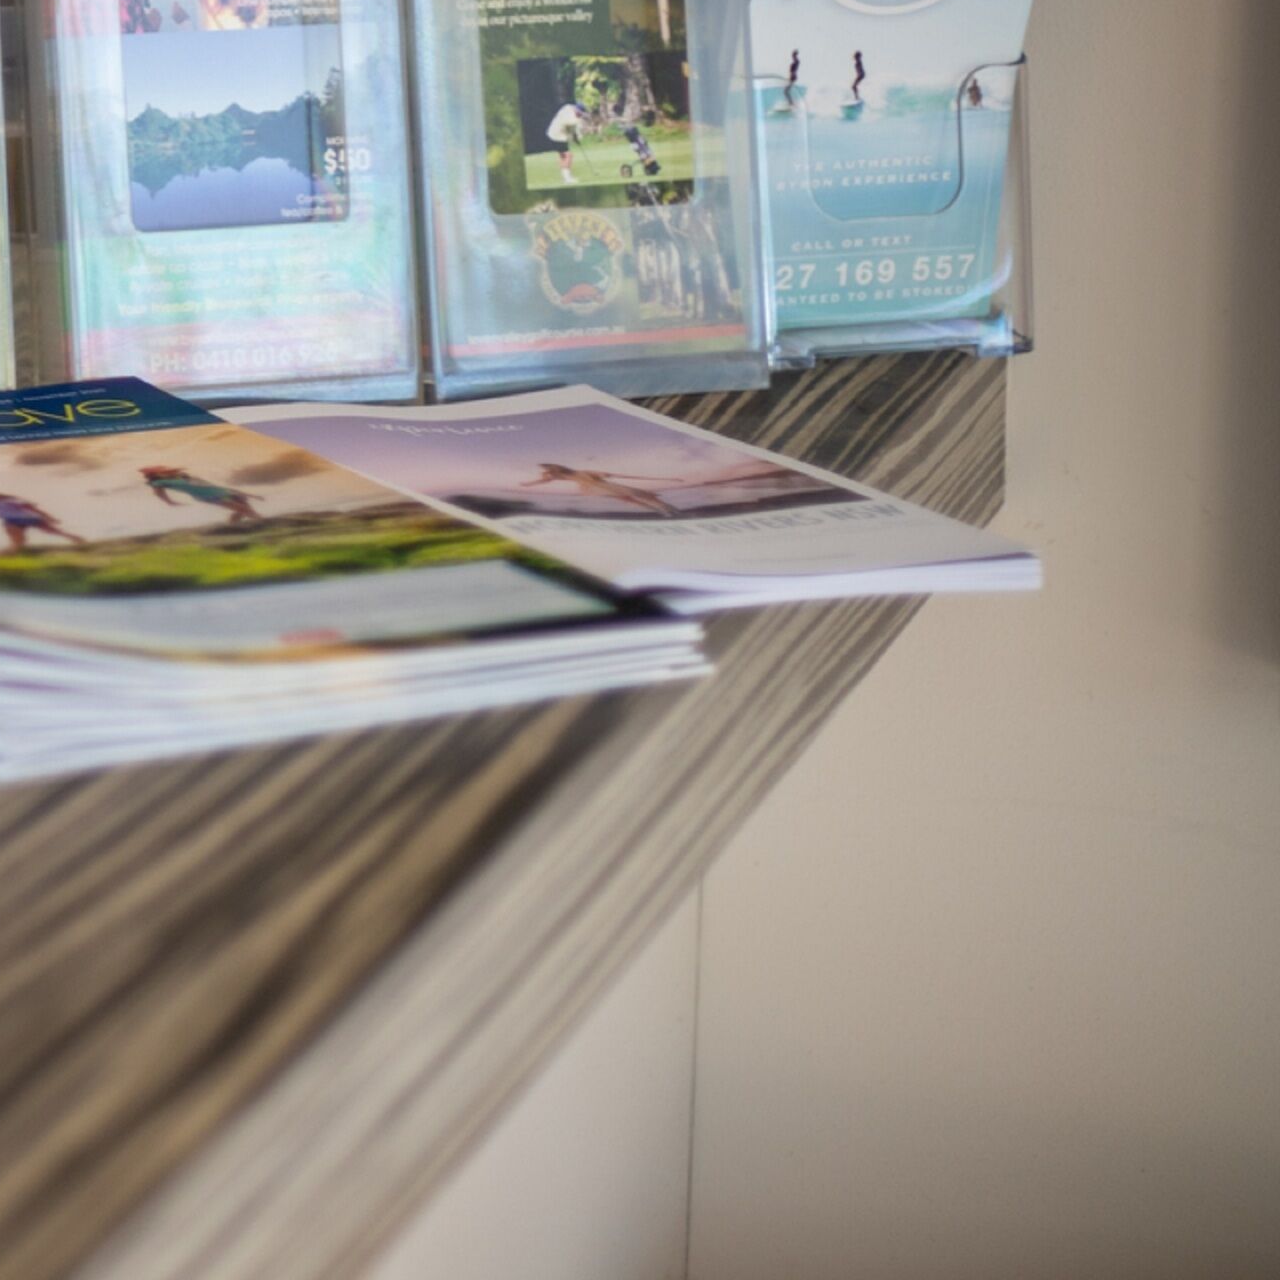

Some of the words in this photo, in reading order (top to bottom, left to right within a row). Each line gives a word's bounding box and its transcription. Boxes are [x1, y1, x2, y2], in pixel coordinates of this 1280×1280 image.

[833, 155, 934, 171] AUTHENTIC
[841, 171, 953, 188] EXPERIENCE
[791, 241, 835, 253] CALL
[841, 238, 864, 249] OR
[871, 235, 912, 247] TEXT
[836, 258, 896, 288] 169
[912, 253, 976, 282] 557
[848, 290, 867, 302] TO
